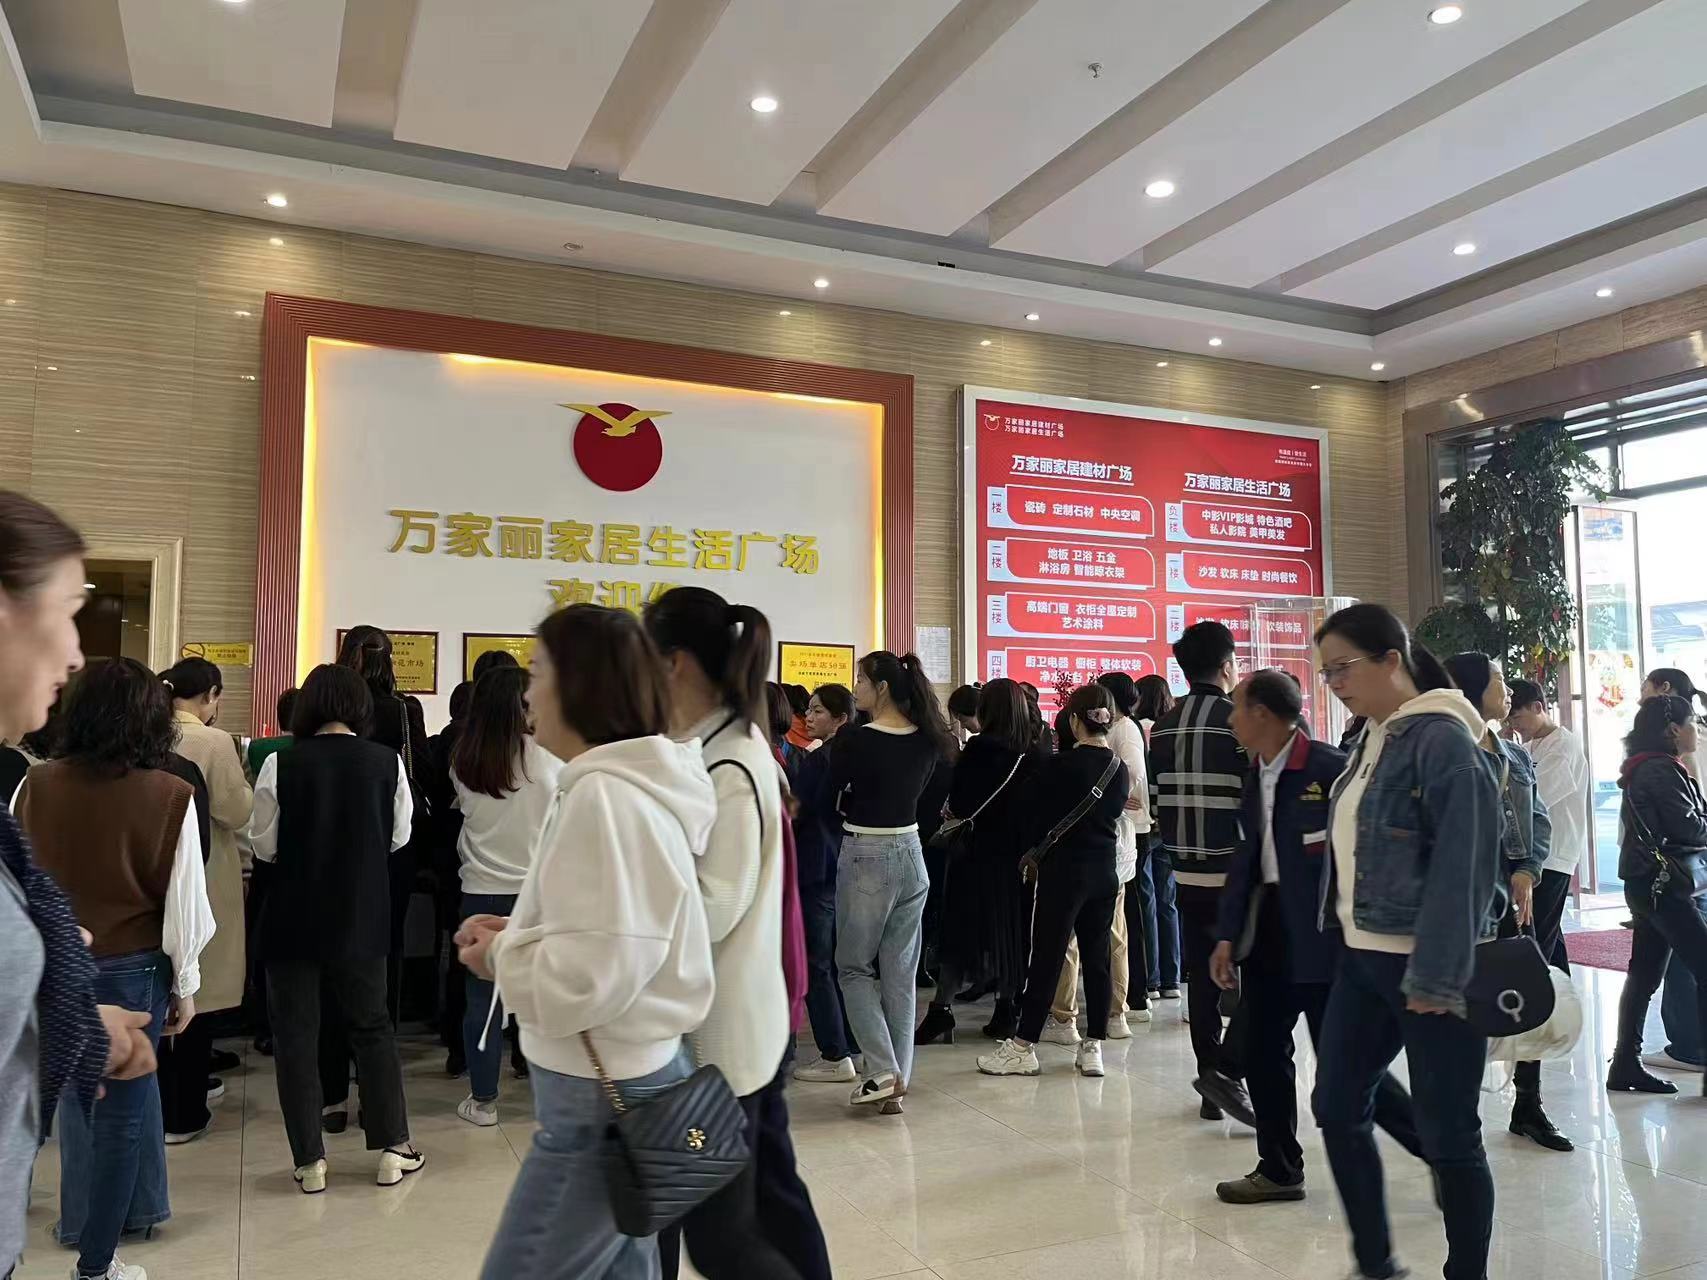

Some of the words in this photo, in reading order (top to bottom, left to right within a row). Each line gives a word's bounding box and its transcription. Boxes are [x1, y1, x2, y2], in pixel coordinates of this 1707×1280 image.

[1005, 417, 1064, 430] 万家丽家居建材广场
[1005, 425, 1064, 438] 万家丽家居生活广场
[1011, 455, 1133, 481] 万家丽家居建材广场
[1184, 472, 1291, 498] 万家丽家居生活广场
[992, 493, 1002, 513] 一楼
[1024, 501, 1046, 514] 瓷砖
[1052, 504, 1094, 518] 定制石材
[1100, 508, 1141, 522] 中央空调
[1201, 509, 1255, 525] 中影VIP影城
[1257, 514, 1292, 529] 特色酒吧
[1209, 523, 1247, 538] 私人影院
[1250, 527, 1286, 541] 美甲美发
[387, 510, 819, 574] 万家丽家居生活广场
[992, 545, 1002, 569] 二楼
[1047, 548, 1069, 561] 地板
[1072, 550, 1093, 563] 卫浴
[1096, 552, 1117, 564] 五金
[1039, 562, 1070, 575] 淋浴房
[1074, 564, 1125, 579] 智能晾衣架
[1198, 566, 1217, 578] 沙发
[1220, 568, 1239, 580] 软床
[1262, 571, 1298, 584] 时尚餐饮
[546, 578, 681, 614] 欢迎
[992, 600, 1002, 624] 三楼
[1026, 600, 1069, 614] 高端门窗
[1075, 603, 1137, 618] 衣柜全屋定制
[1061, 617, 1104, 630] 艺术涂料
[1025, 656, 1069, 669] 厨卫电器
[1075, 657, 1096, 670] 橱柜
[1101, 657, 1142, 671] 整体软装
